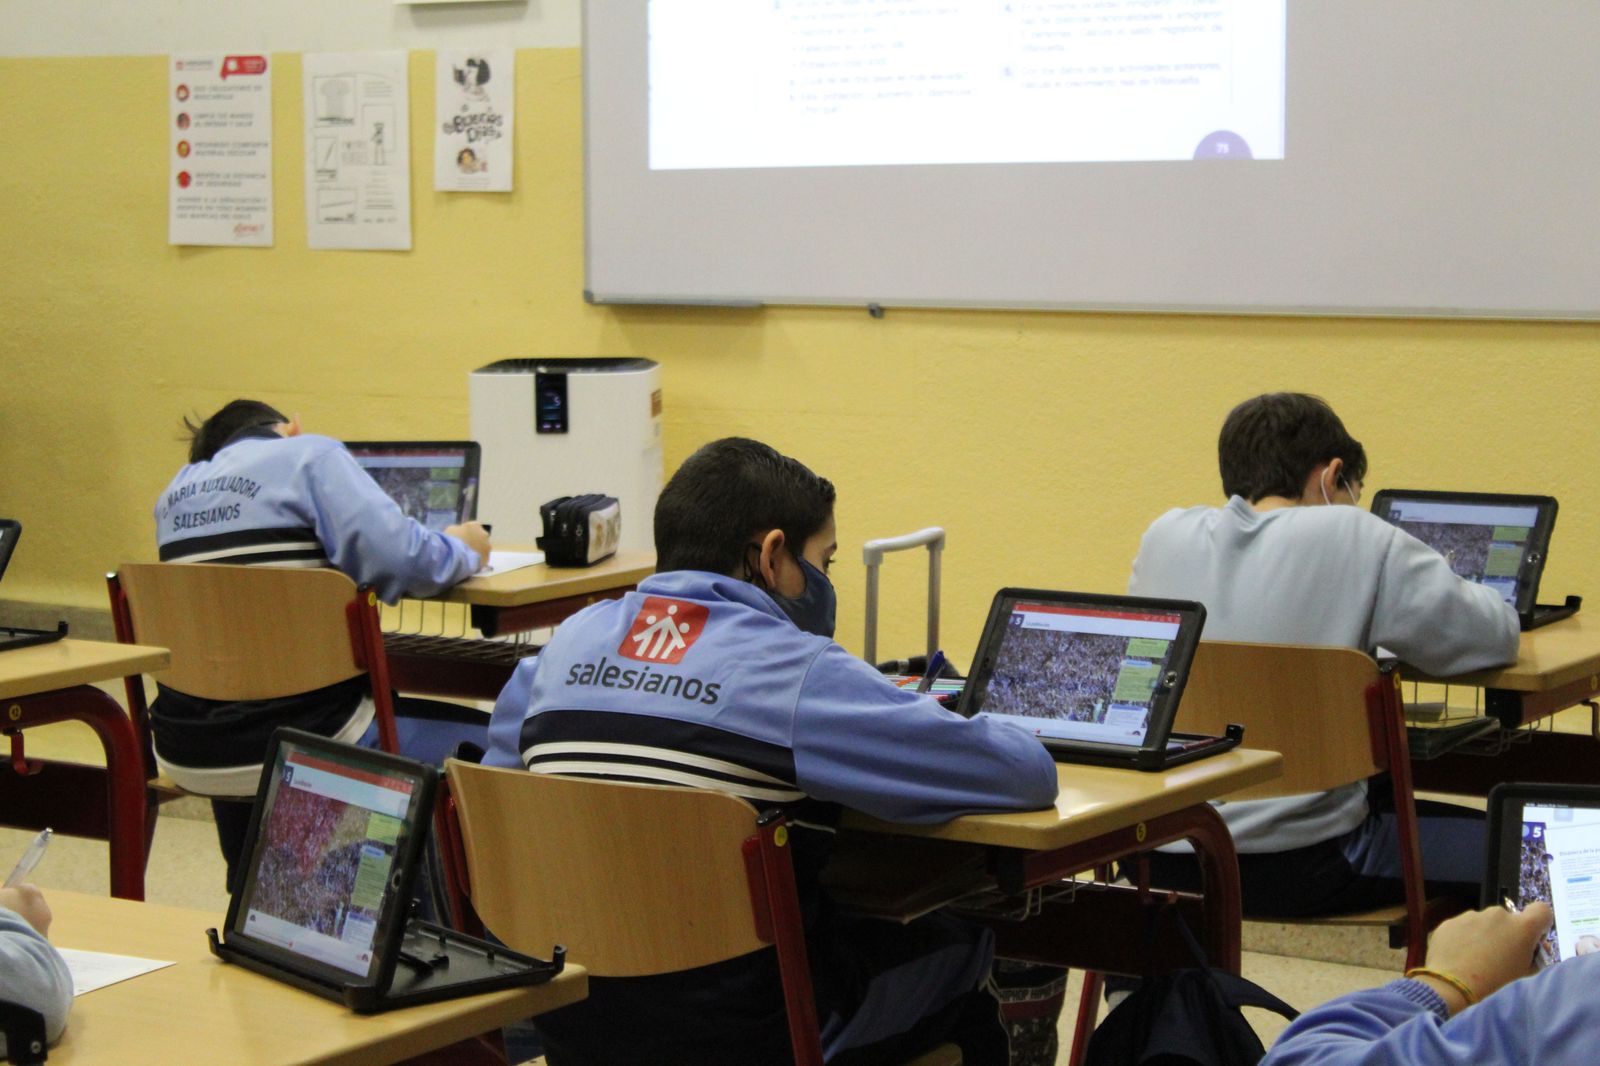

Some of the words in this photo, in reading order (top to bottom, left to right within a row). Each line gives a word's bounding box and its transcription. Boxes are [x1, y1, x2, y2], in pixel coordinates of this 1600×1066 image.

[200, 475, 262, 501] AUXILIADORA
[173, 502, 241, 532] SALESIANOS
[1015, 617, 1022, 625] 5
[564, 656, 722, 706] salesianos
[1533, 826, 1542, 838] 5
